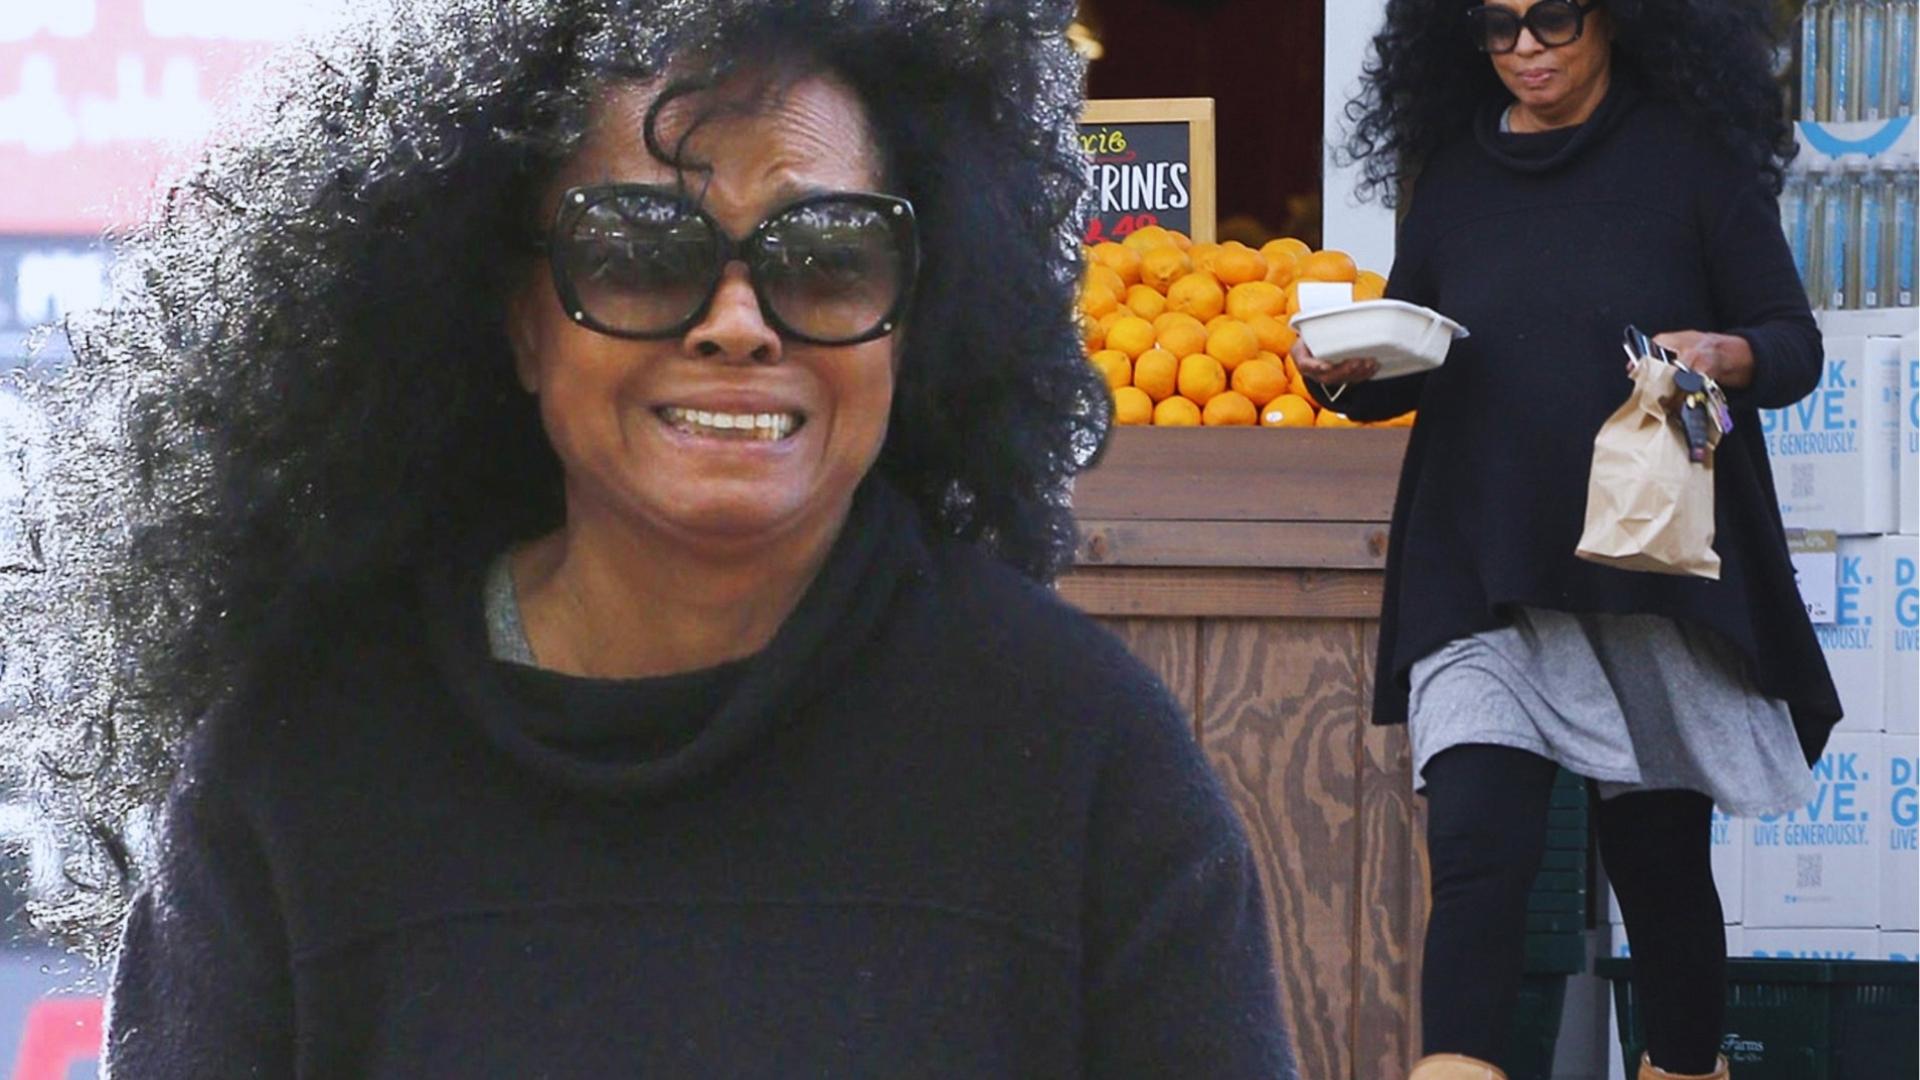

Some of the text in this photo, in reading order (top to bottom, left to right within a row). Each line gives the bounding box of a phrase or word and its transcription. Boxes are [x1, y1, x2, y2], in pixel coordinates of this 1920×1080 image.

[1080, 127, 1127, 153] xie
[1088, 162, 1188, 212] ERINES
[1780, 432, 1858, 455] GENEROUSLY.
[1817, 625, 1873, 650] ROUSLY.
[1813, 753, 1869, 781] NK.
[1755, 824, 1779, 846] LIVE
[1785, 823, 1869, 846] GENEROUSLY.
[1890, 829, 1918, 850] LIVE
